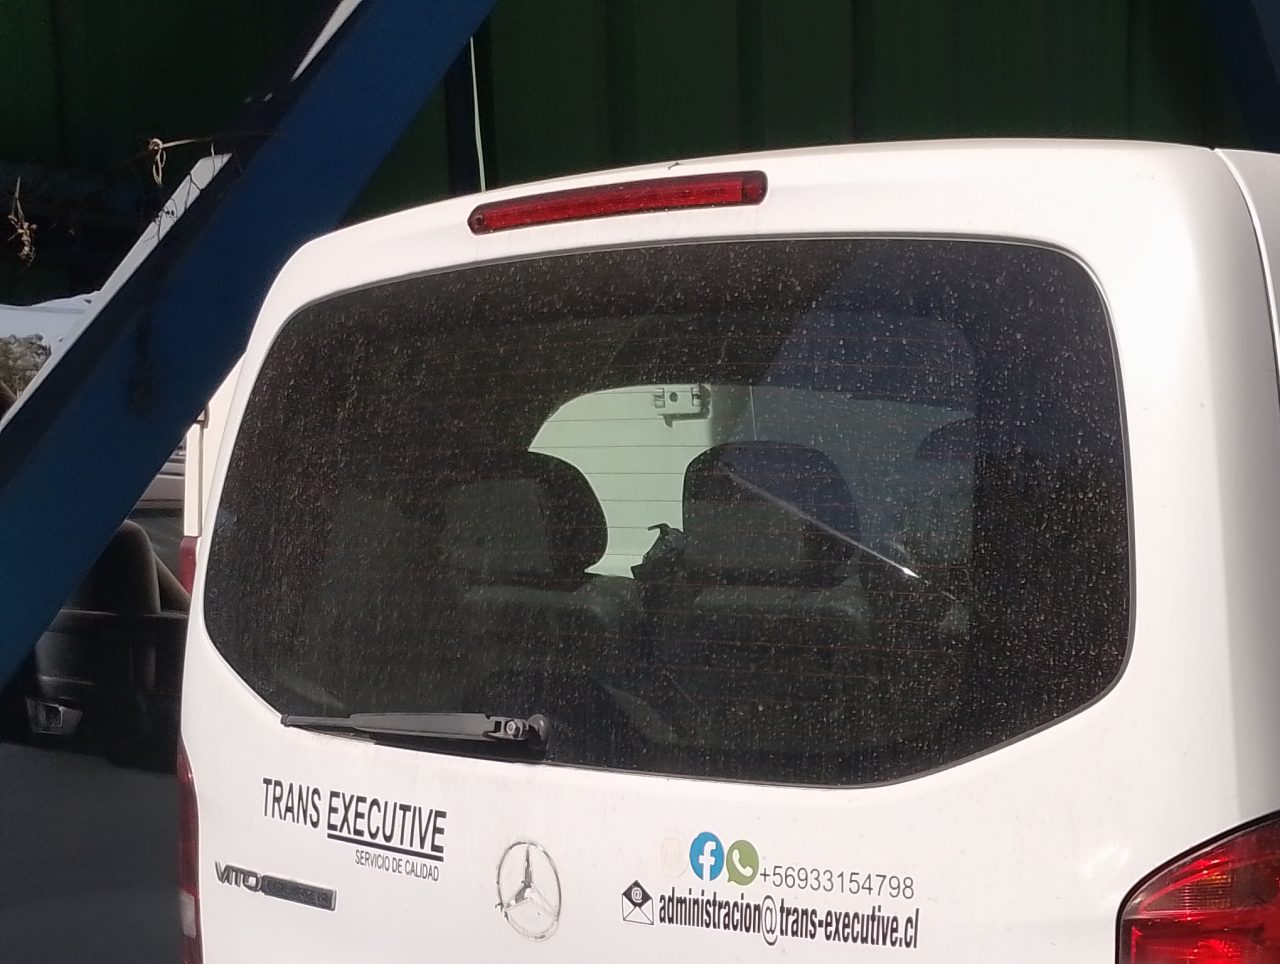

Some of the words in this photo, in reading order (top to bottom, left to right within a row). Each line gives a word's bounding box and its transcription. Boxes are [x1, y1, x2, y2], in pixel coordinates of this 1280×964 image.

[262, 777, 321, 829] TRANS
[326, 790, 447, 852] EXECUTIVE
[214, 861, 263, 892] VITO
[355, 848, 391, 872] SERVICIO
[392, 857, 403, 874] DE
[404, 859, 440, 882] CALIDAD
[759, 865, 915, 900] +56933154798
[658, 886, 920, 949] administracion@trans-executive.cl
